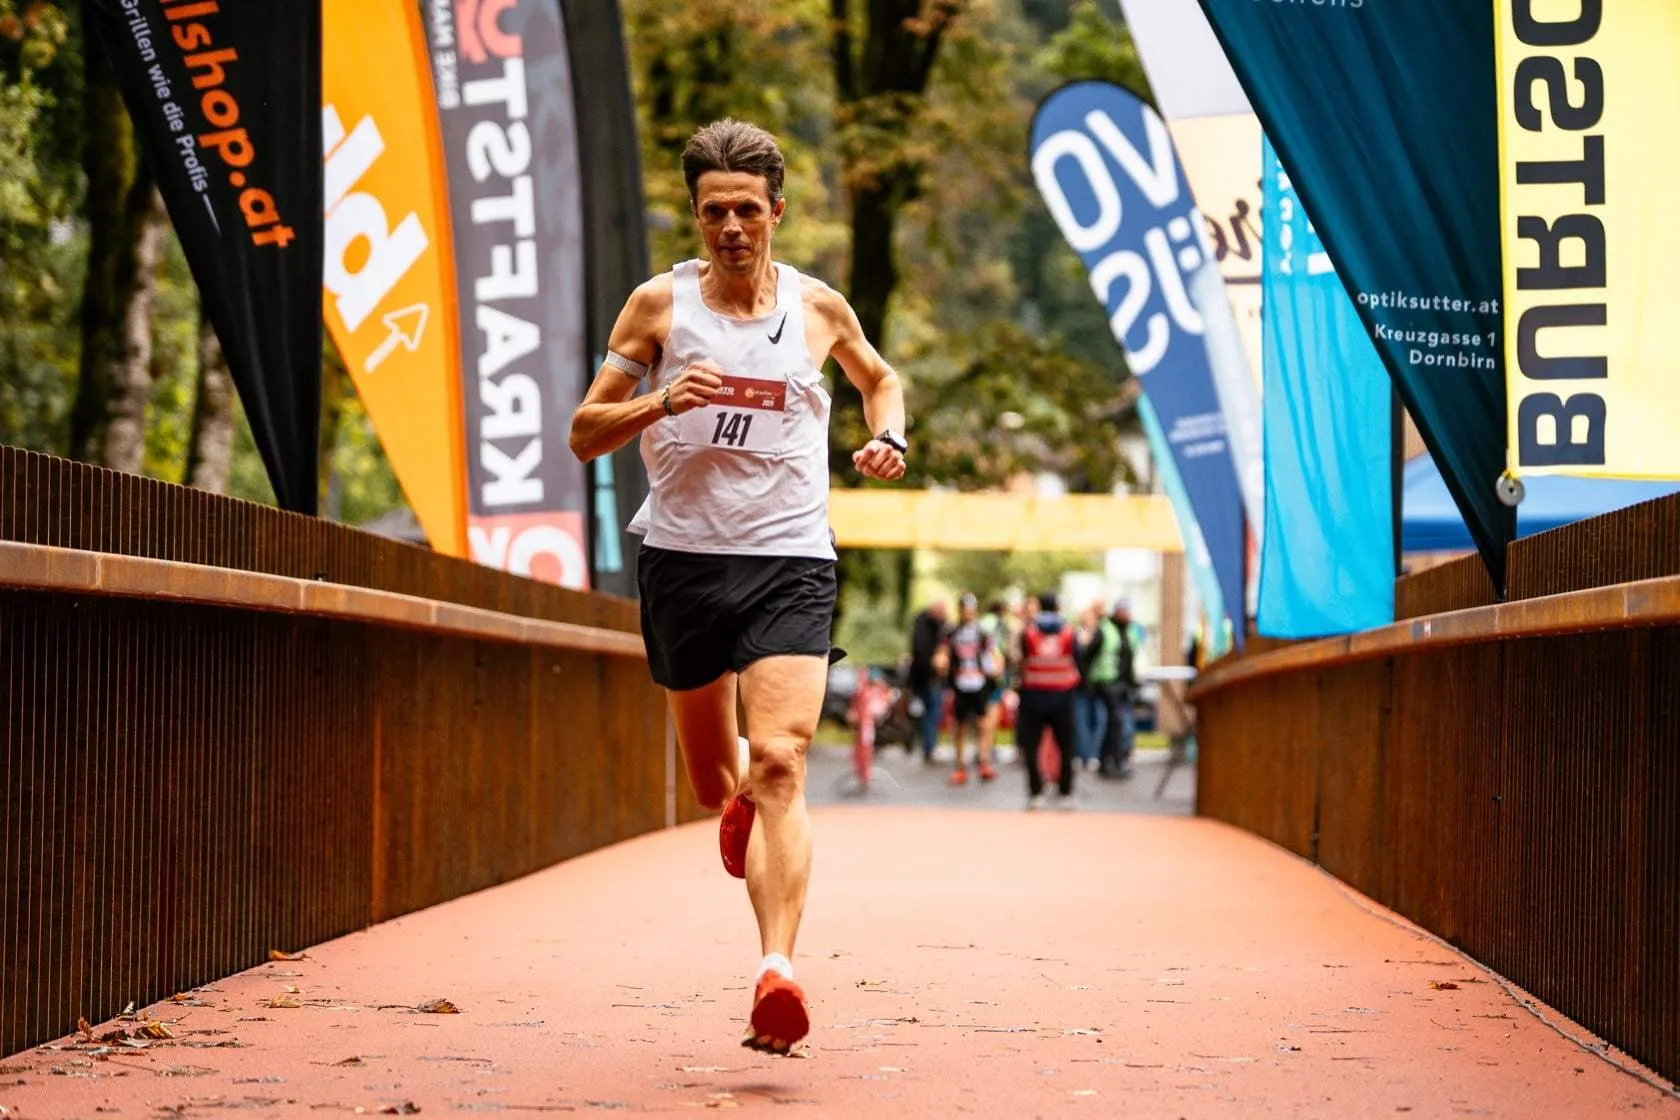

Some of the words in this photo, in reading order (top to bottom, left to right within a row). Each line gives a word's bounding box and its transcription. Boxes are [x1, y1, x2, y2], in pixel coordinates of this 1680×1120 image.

[120, 0, 157, 62] Grillen
[148, 63, 171, 99] wie
[163, 102, 185, 132] die
[176, 134, 208, 192] Profis
[159, 0, 295, 248] lshop.at
[1356, 290, 1499, 314] optiksutter.at
[1375, 323, 1482, 347] Kreuzgasse
[1487, 332, 1496, 347] 1
[1409, 349, 1496, 369] Dornbirn
[711, 411, 753, 447] 141
